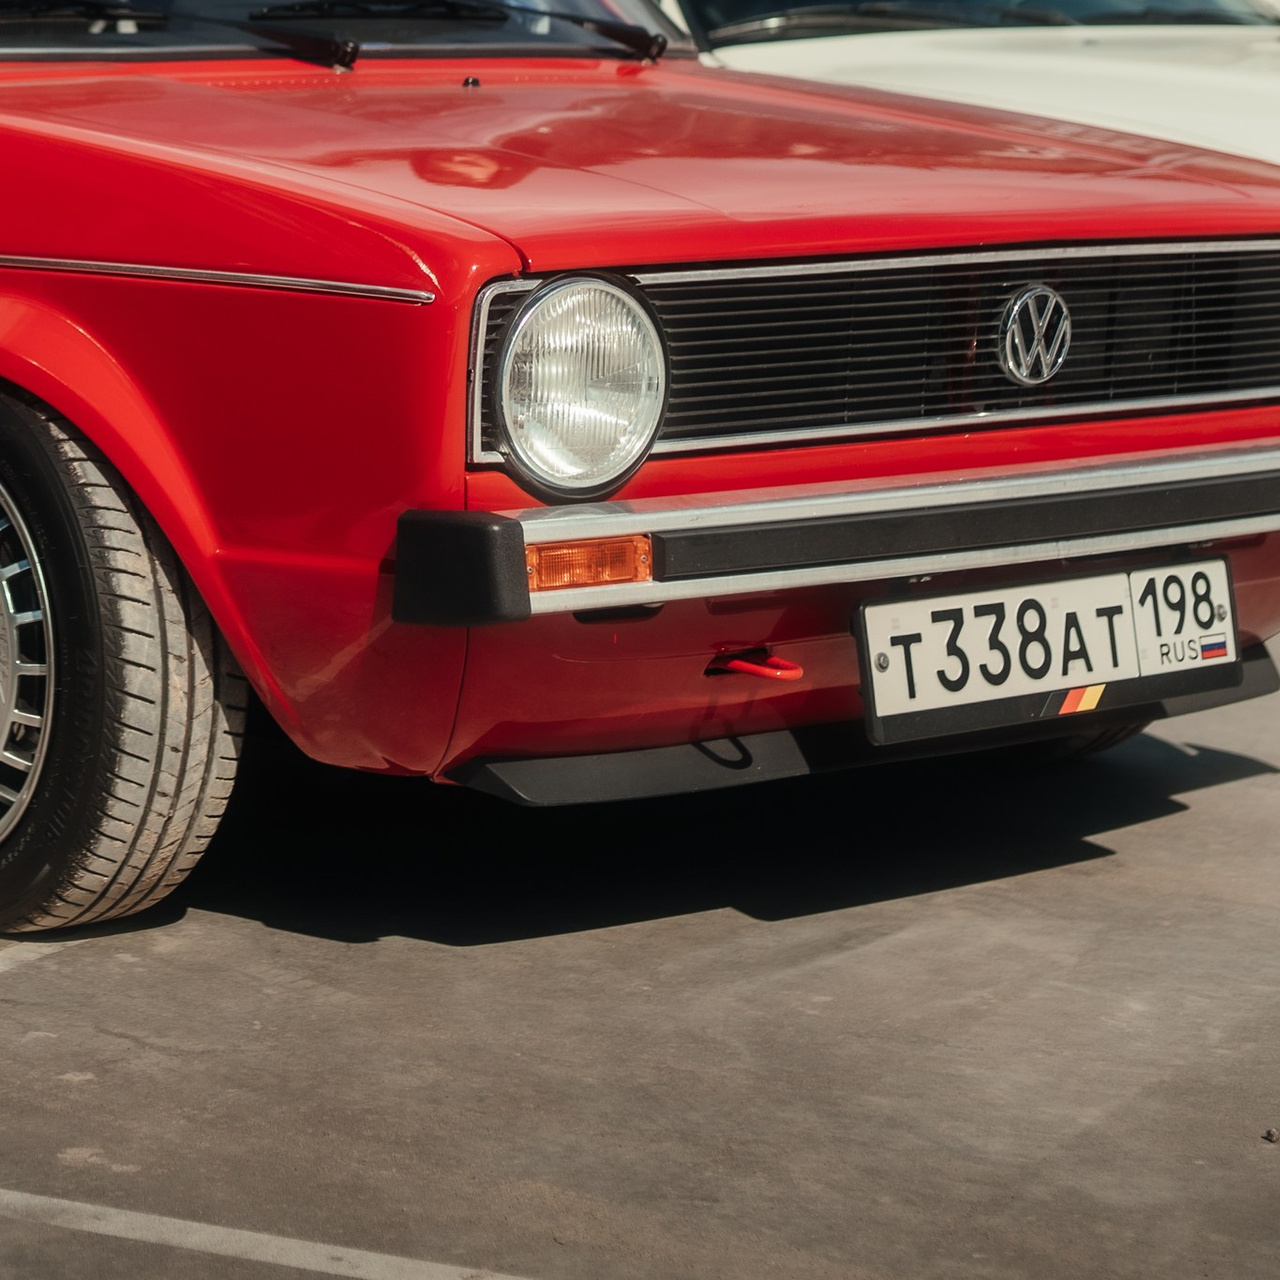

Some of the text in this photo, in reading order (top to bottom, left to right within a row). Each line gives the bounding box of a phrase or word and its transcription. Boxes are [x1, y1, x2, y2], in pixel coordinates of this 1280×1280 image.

[889, 571, 1216, 699] T338AT 198
[1160, 639, 1199, 665] RUS
